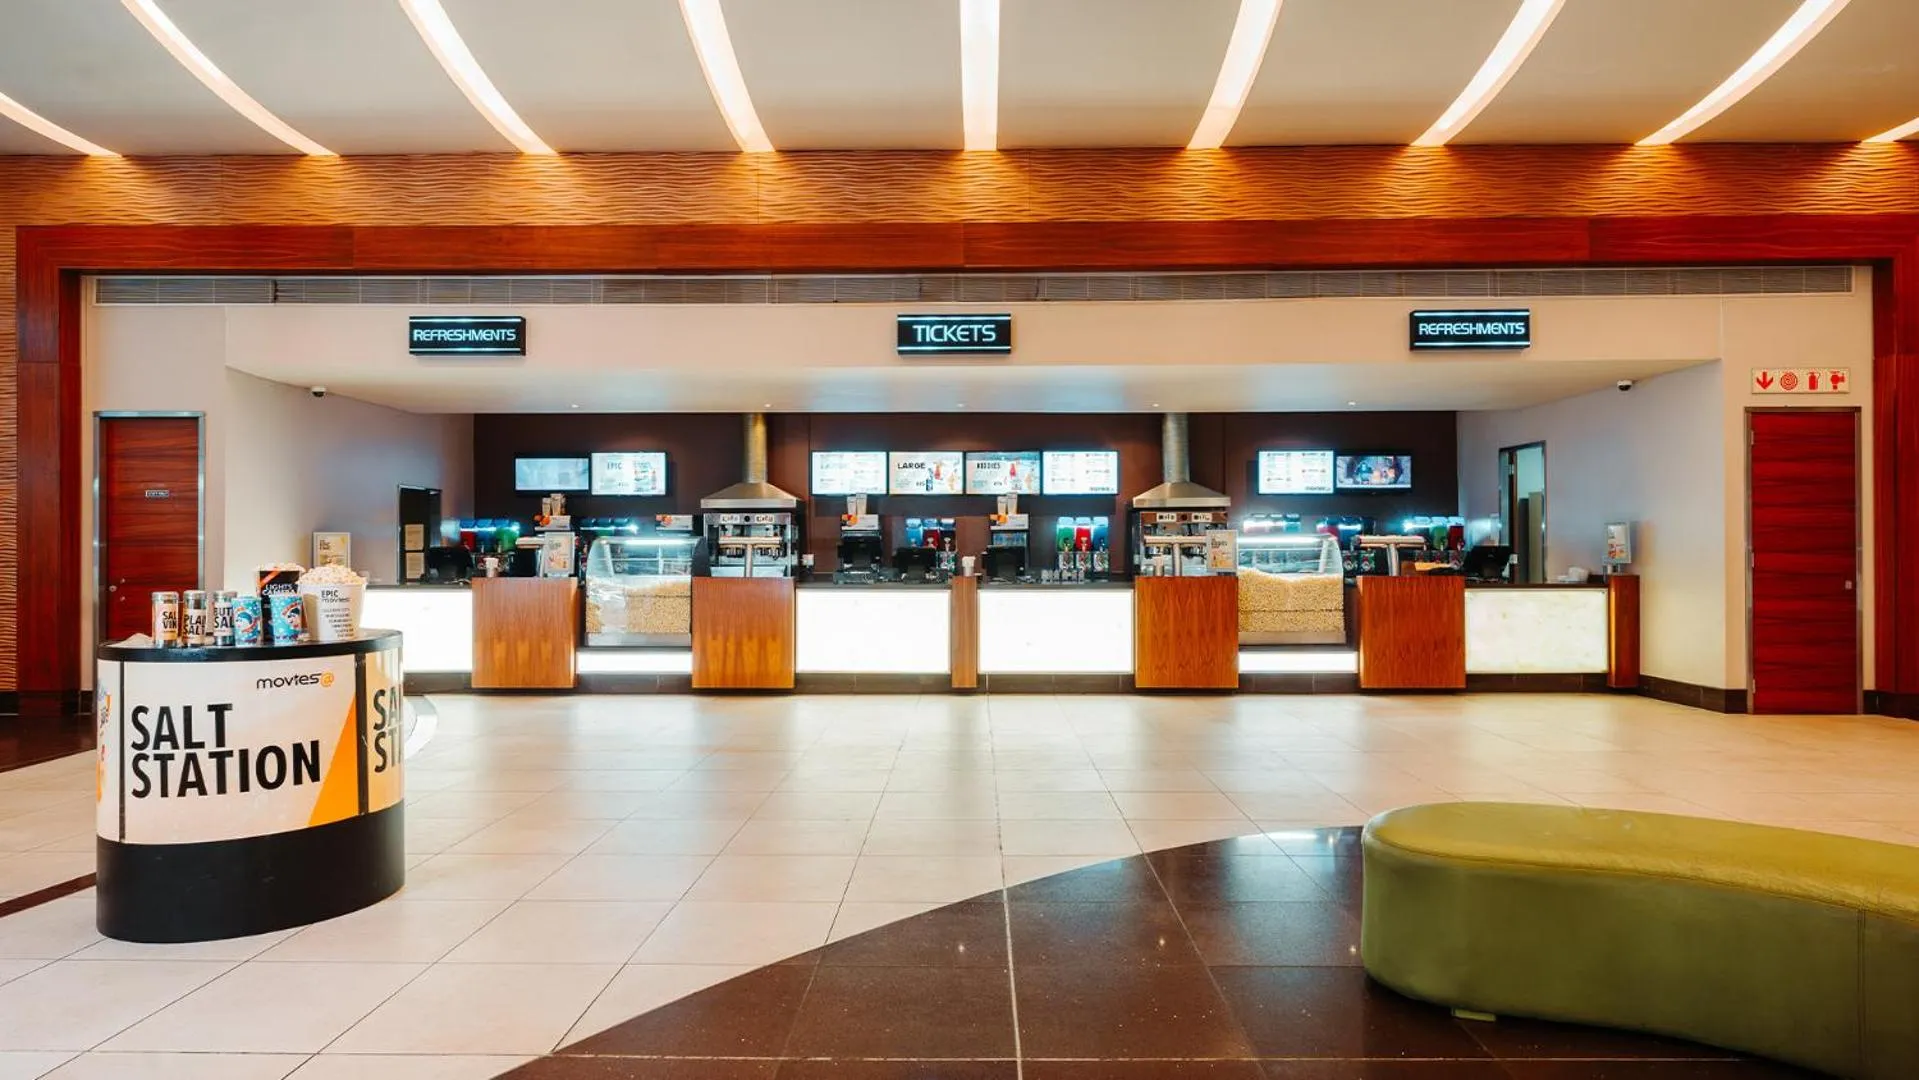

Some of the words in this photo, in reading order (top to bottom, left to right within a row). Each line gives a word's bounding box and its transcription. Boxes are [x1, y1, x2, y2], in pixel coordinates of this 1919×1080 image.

[413, 328, 517, 342] REFRESHMENTS
[912, 324, 996, 342] TICKETS
[1418, 322, 1526, 336] REFRESHMENTS
[897, 462, 926, 470] LARGE
[321, 589, 339, 598] EPIC
[131, 703, 233, 751] SALT
[131, 740, 320, 798] STATION
